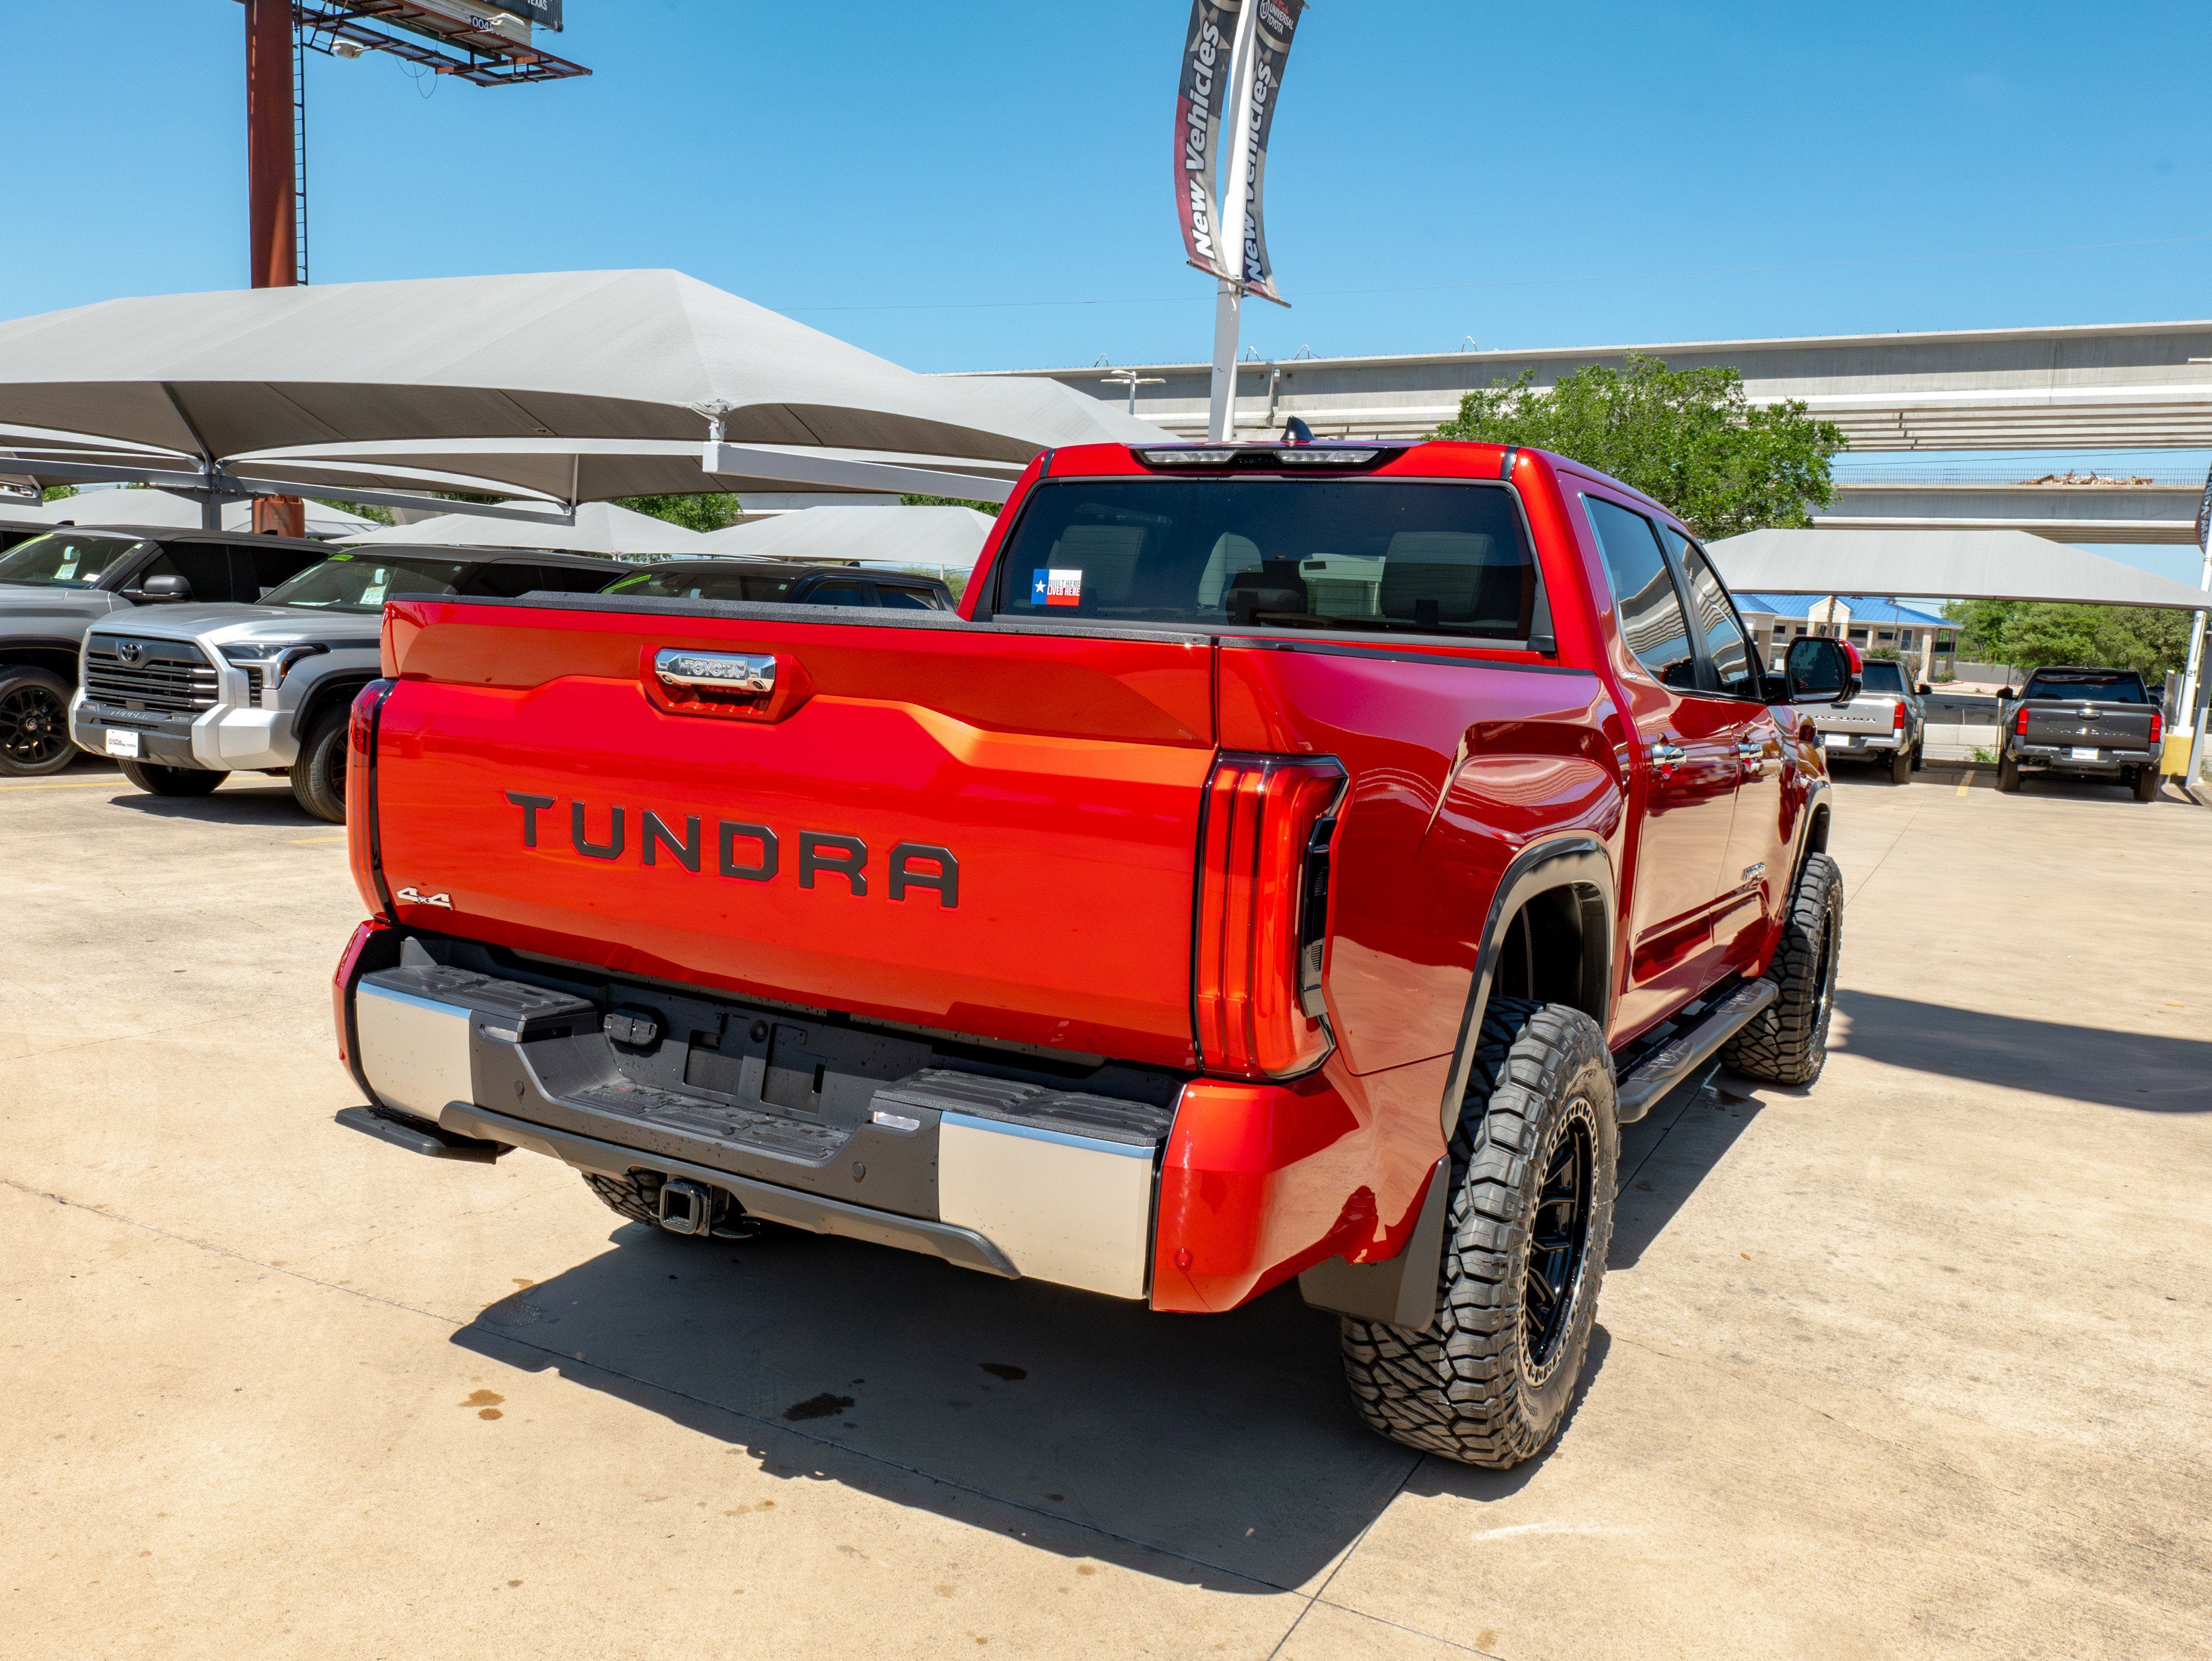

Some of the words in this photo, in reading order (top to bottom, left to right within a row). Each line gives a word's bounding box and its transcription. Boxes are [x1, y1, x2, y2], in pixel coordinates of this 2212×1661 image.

[1267, 14, 1283, 35] TOYOTA
[1270, 3, 1294, 30] UNIVERSAL
[1186, 20, 1219, 169] Vehicles
[1190, 179, 1215, 259] New
[1047, 587, 1063, 596] LIVES
[1064, 588, 1080, 596] HERE
[1048, 580, 1065, 588] BUILT
[684, 660, 741, 679] TOYOTA
[1814, 715, 1877, 724] ACOMA
[505, 792, 959, 908] TUNDRA
